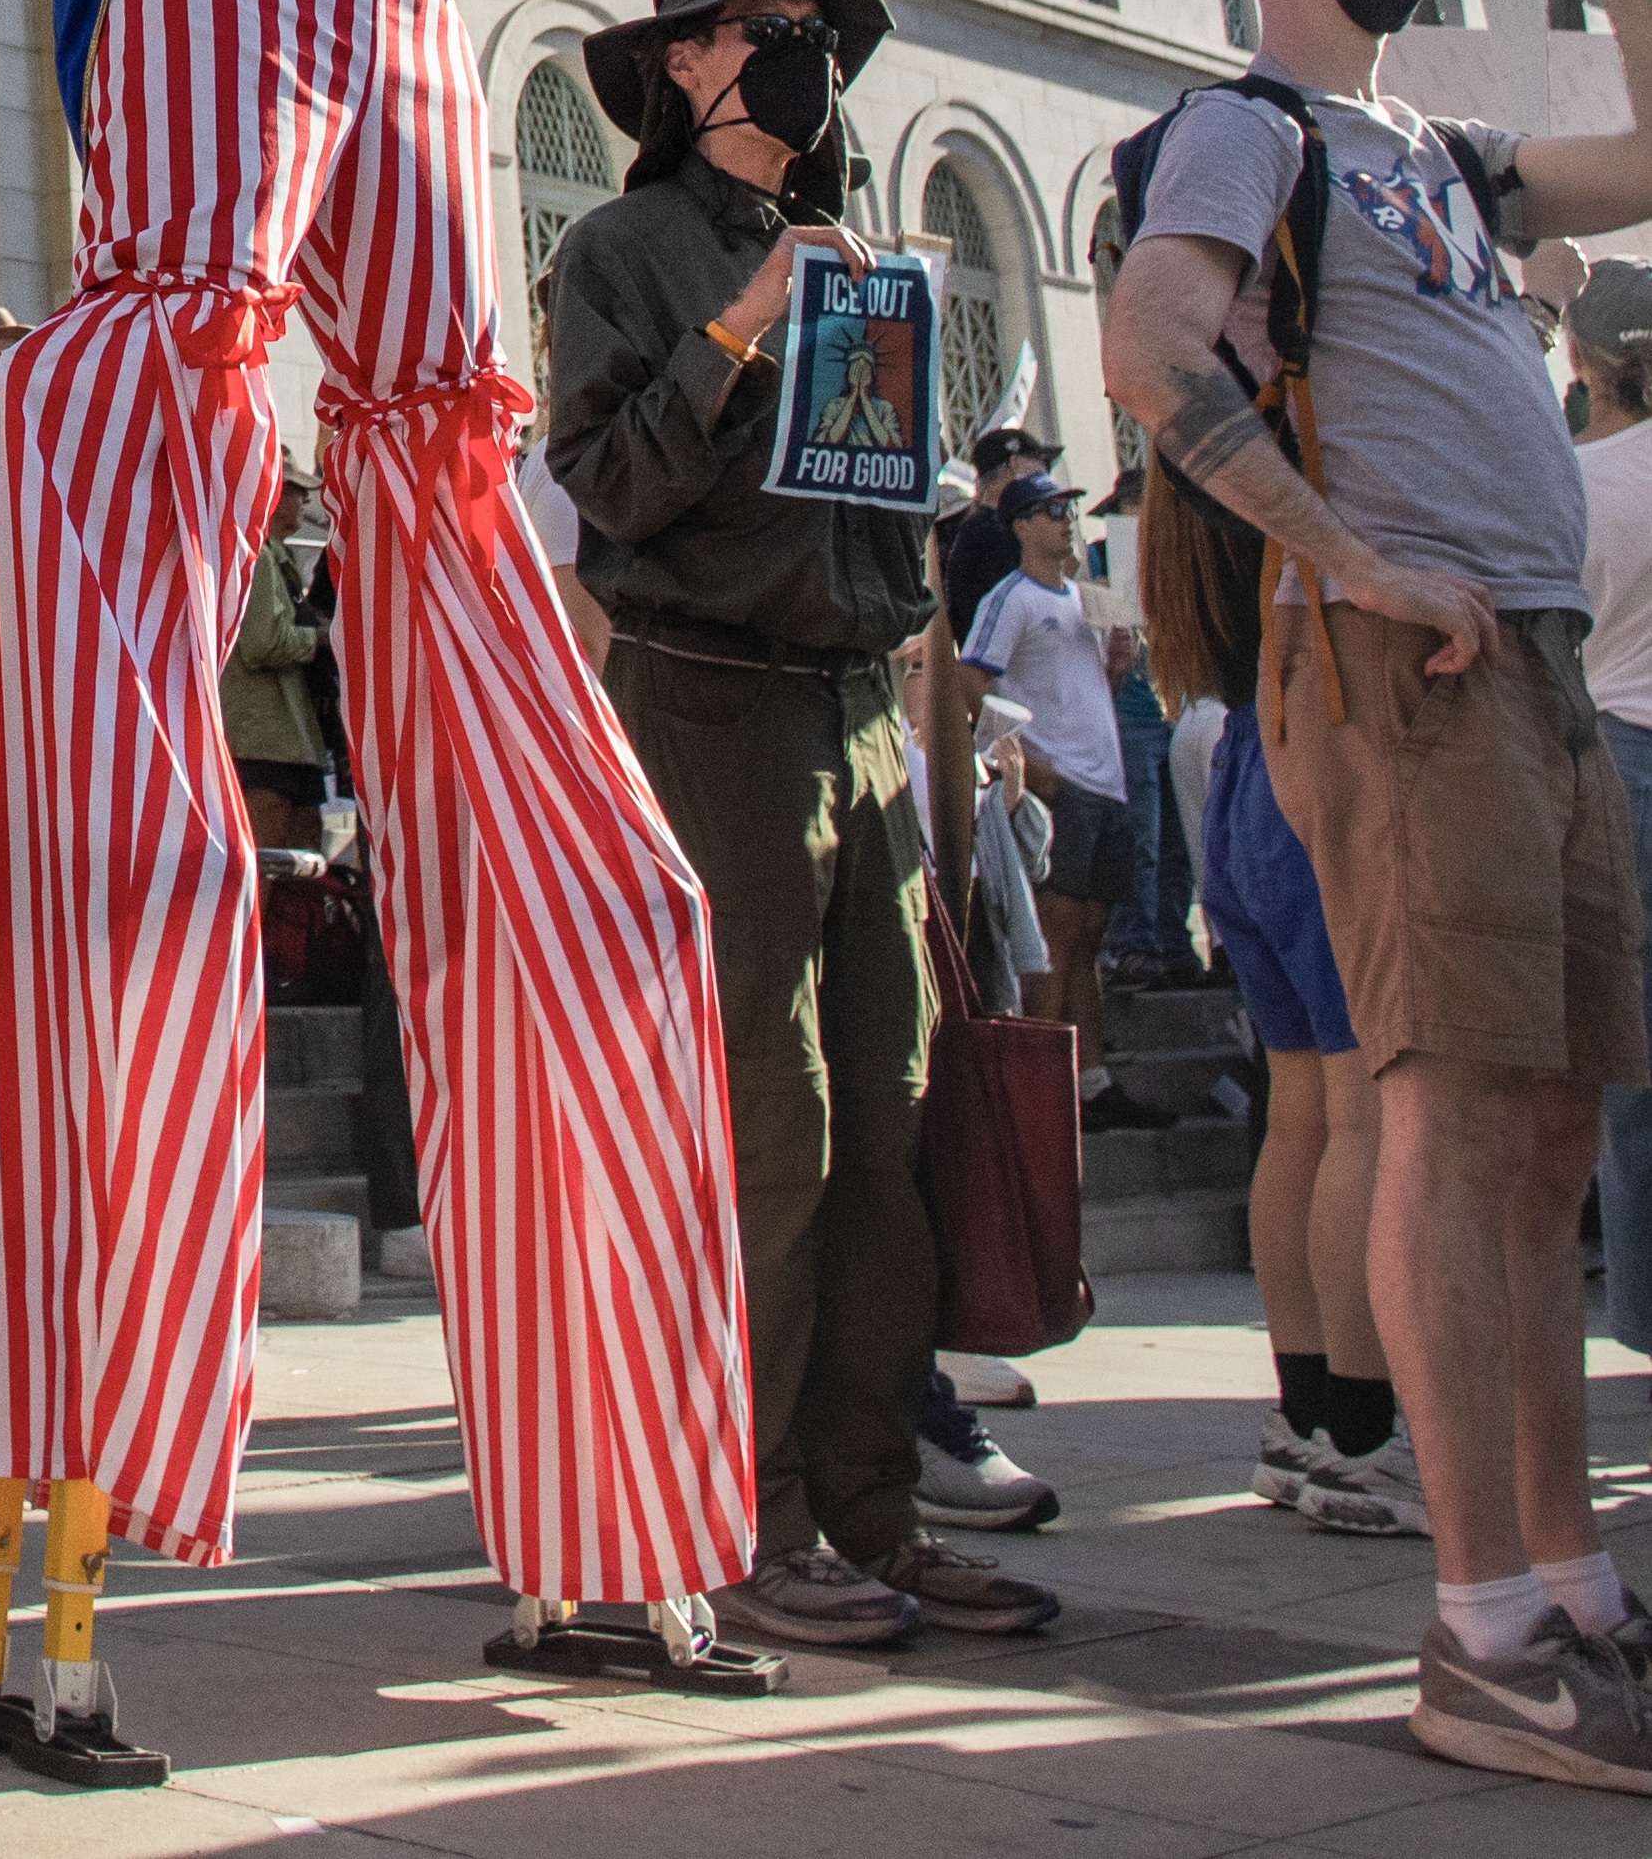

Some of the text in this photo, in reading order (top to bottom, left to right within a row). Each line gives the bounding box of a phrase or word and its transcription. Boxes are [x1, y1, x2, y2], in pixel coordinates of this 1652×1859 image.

[822, 270, 914, 320] ICE OUT
[795, 447, 916, 492] FOR GOOD
